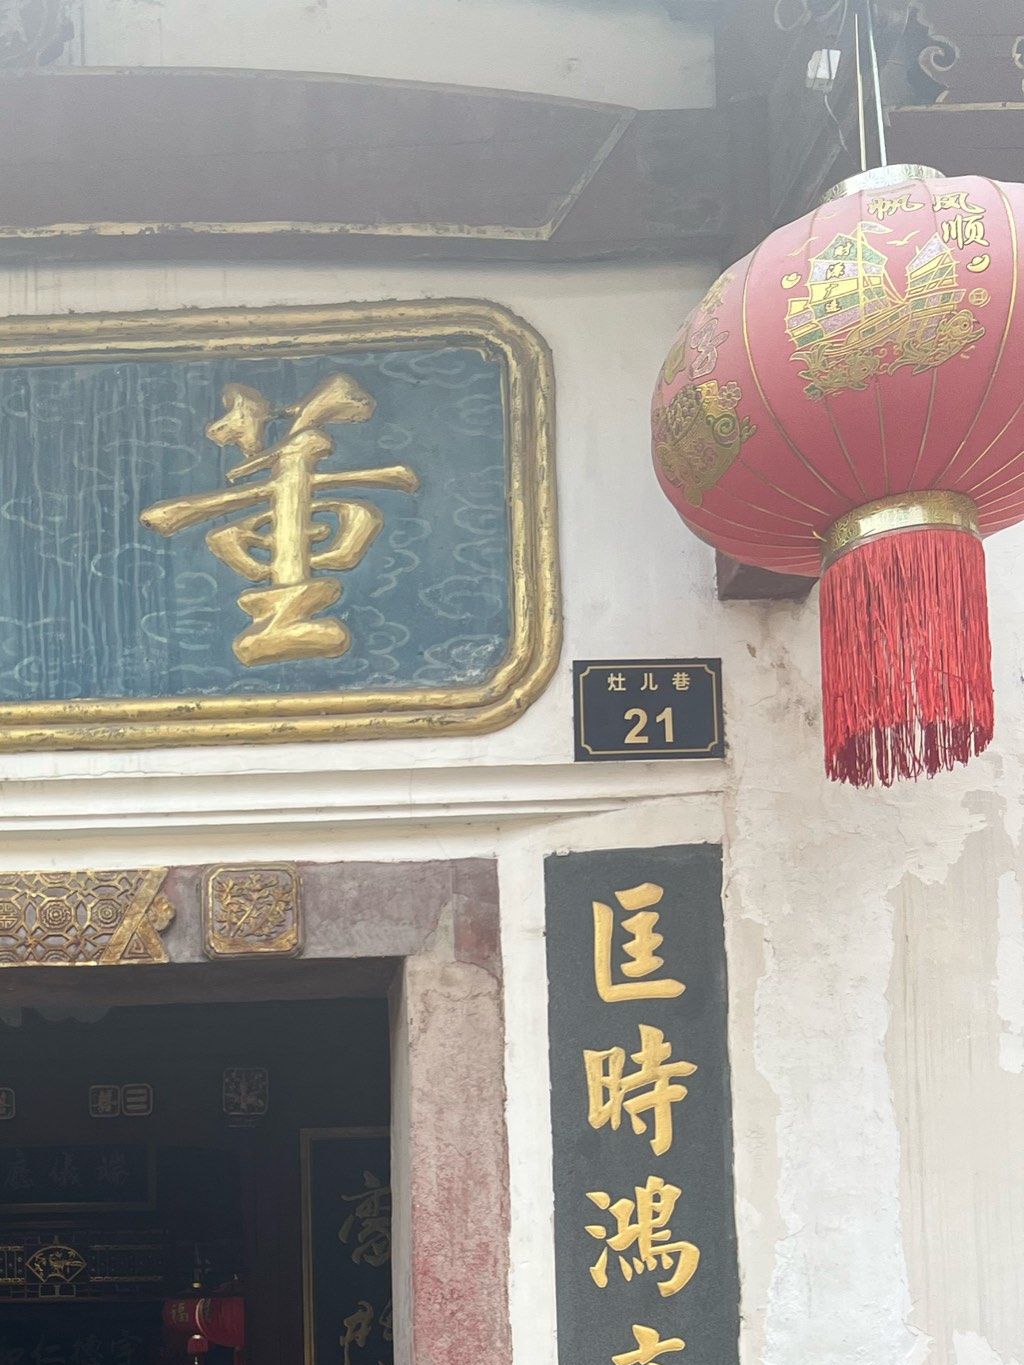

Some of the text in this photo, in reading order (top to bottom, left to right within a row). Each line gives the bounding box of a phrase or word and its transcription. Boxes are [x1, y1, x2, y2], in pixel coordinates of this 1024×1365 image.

[607, 672, 691, 692] 灶儿巷
[624, 707, 674, 744] 21
